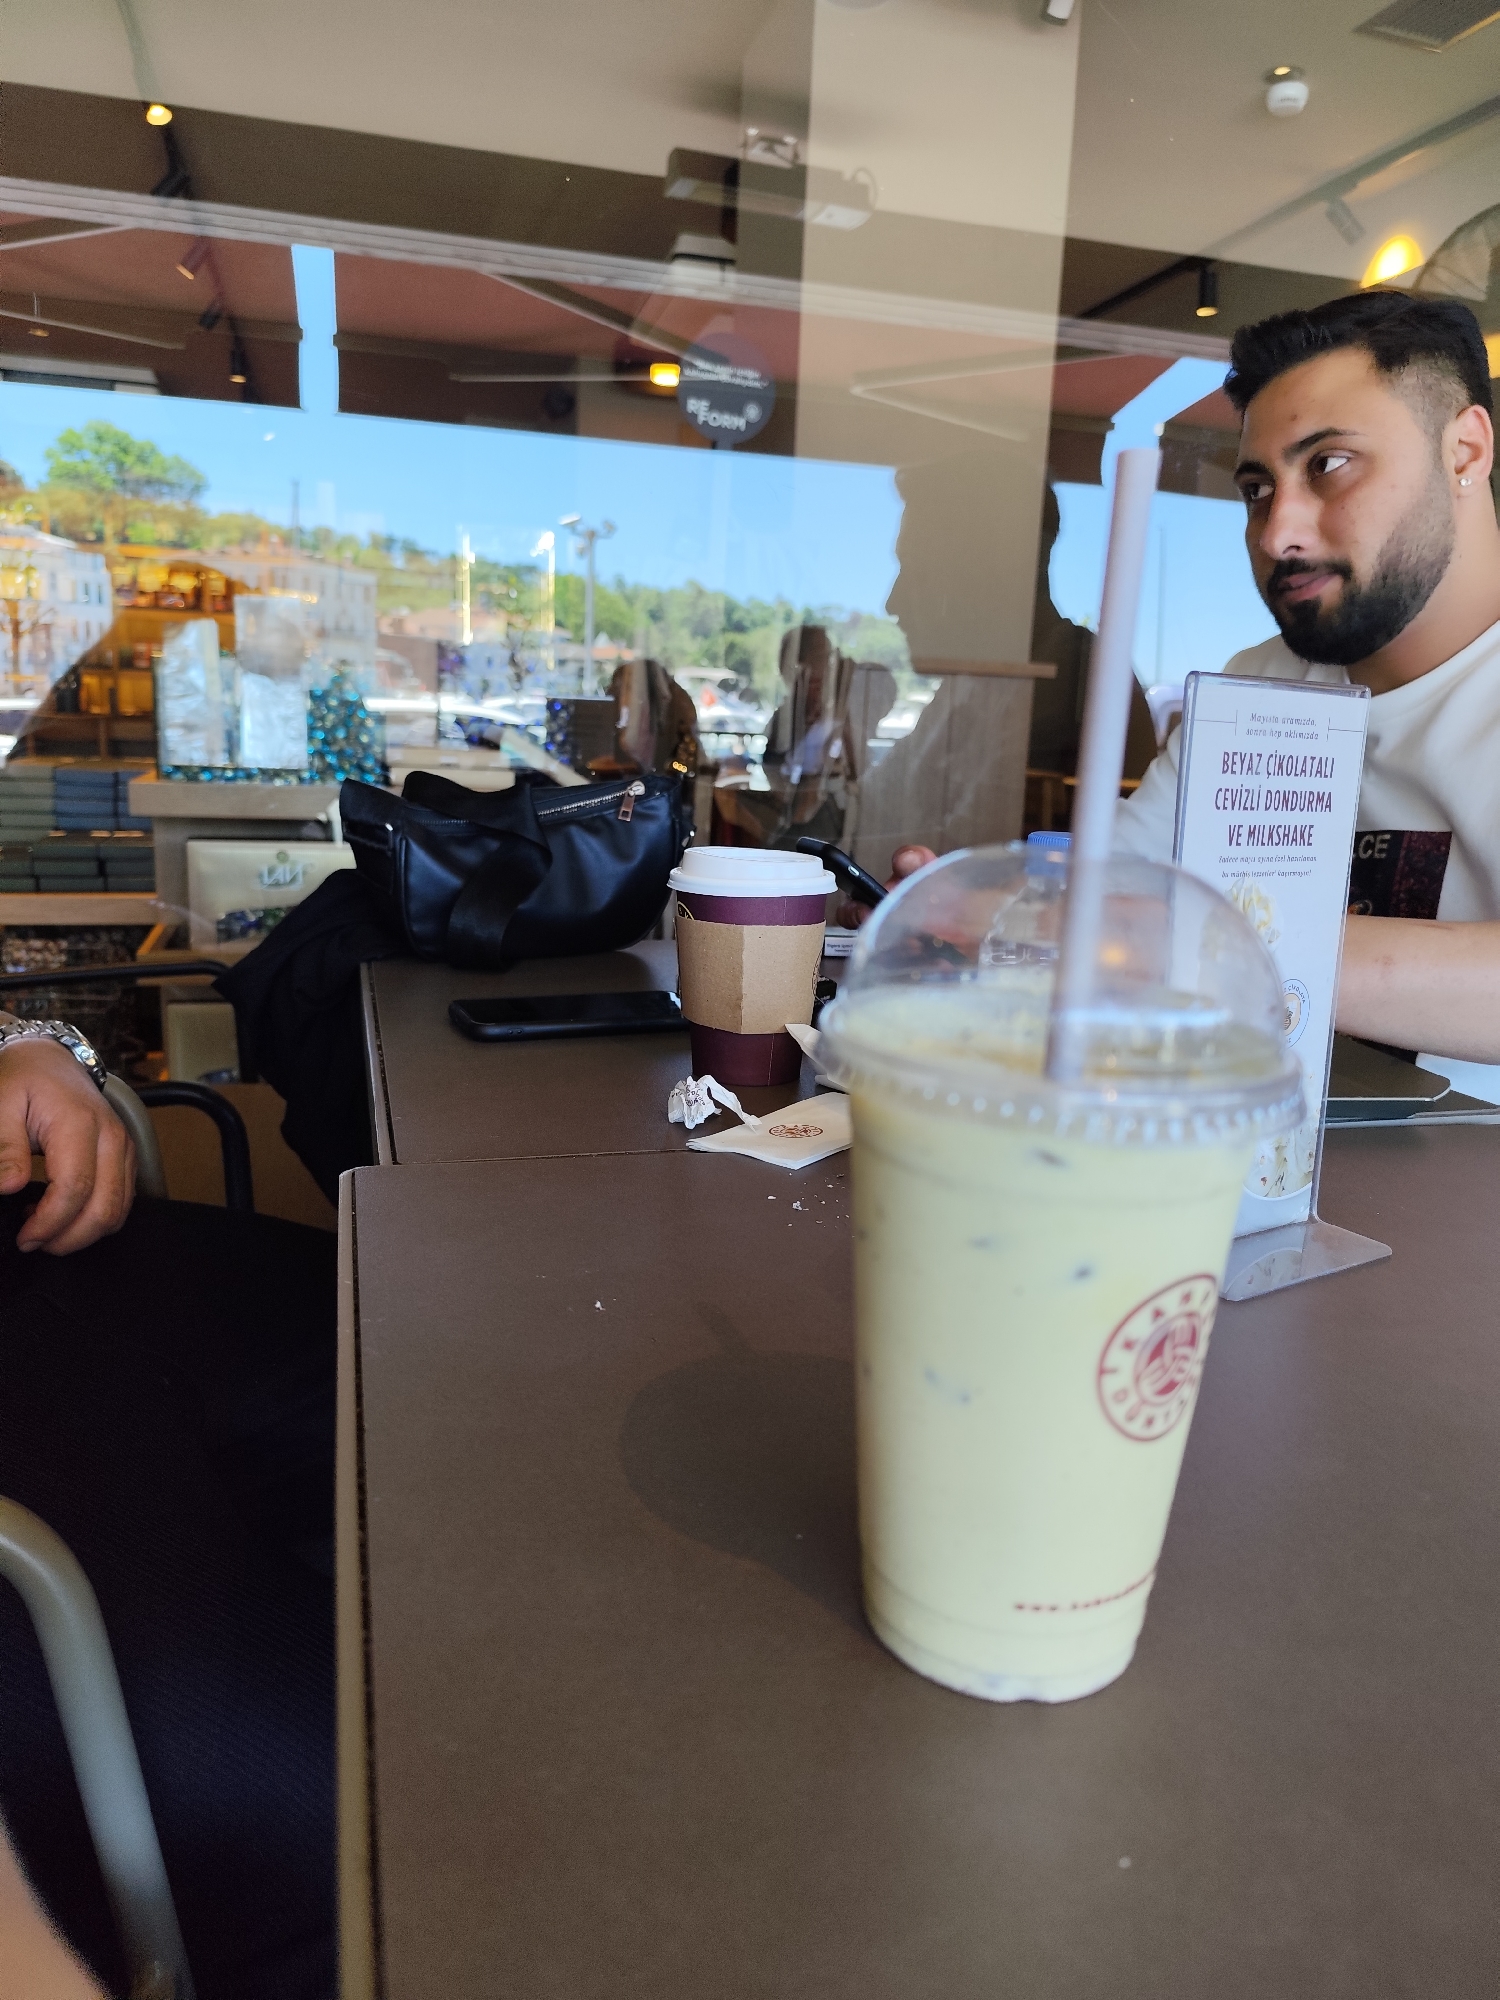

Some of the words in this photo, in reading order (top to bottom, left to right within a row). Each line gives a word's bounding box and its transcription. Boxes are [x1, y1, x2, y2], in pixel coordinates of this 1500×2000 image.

[1284, 729, 1319, 740] aklımızda
[1221, 751, 1263, 776] BEYAZ
[1266, 749, 1335, 780] ÇİKOLATALI
[1214, 783, 1262, 812] CEVİZLİ
[1264, 789, 1332, 813] DONDURMA
[1228, 824, 1244, 847] VE
[1246, 824, 1315, 847] MILKSHAKE
[1353, 832, 1392, 860] CE
